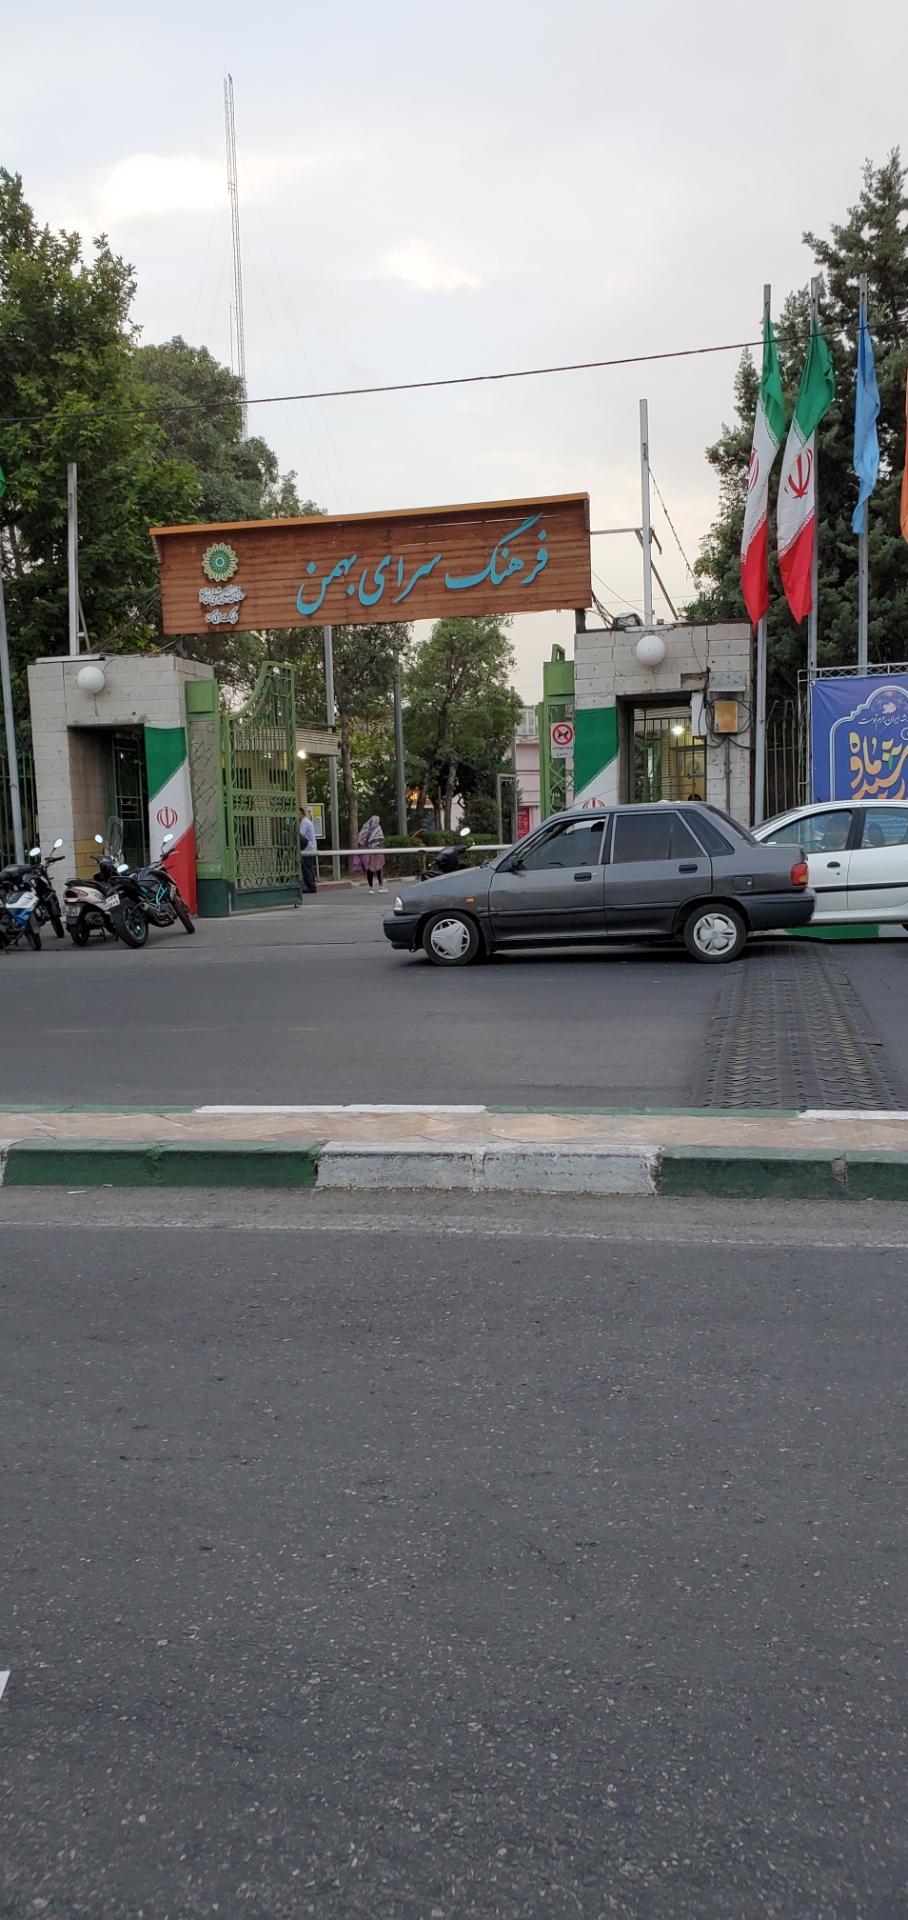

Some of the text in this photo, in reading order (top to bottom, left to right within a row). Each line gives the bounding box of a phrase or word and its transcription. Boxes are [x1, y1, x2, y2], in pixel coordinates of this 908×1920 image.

[295, 513, 550, 616] فرهنگ سرای بهمن
[884, 715, 900, 726] ایران
